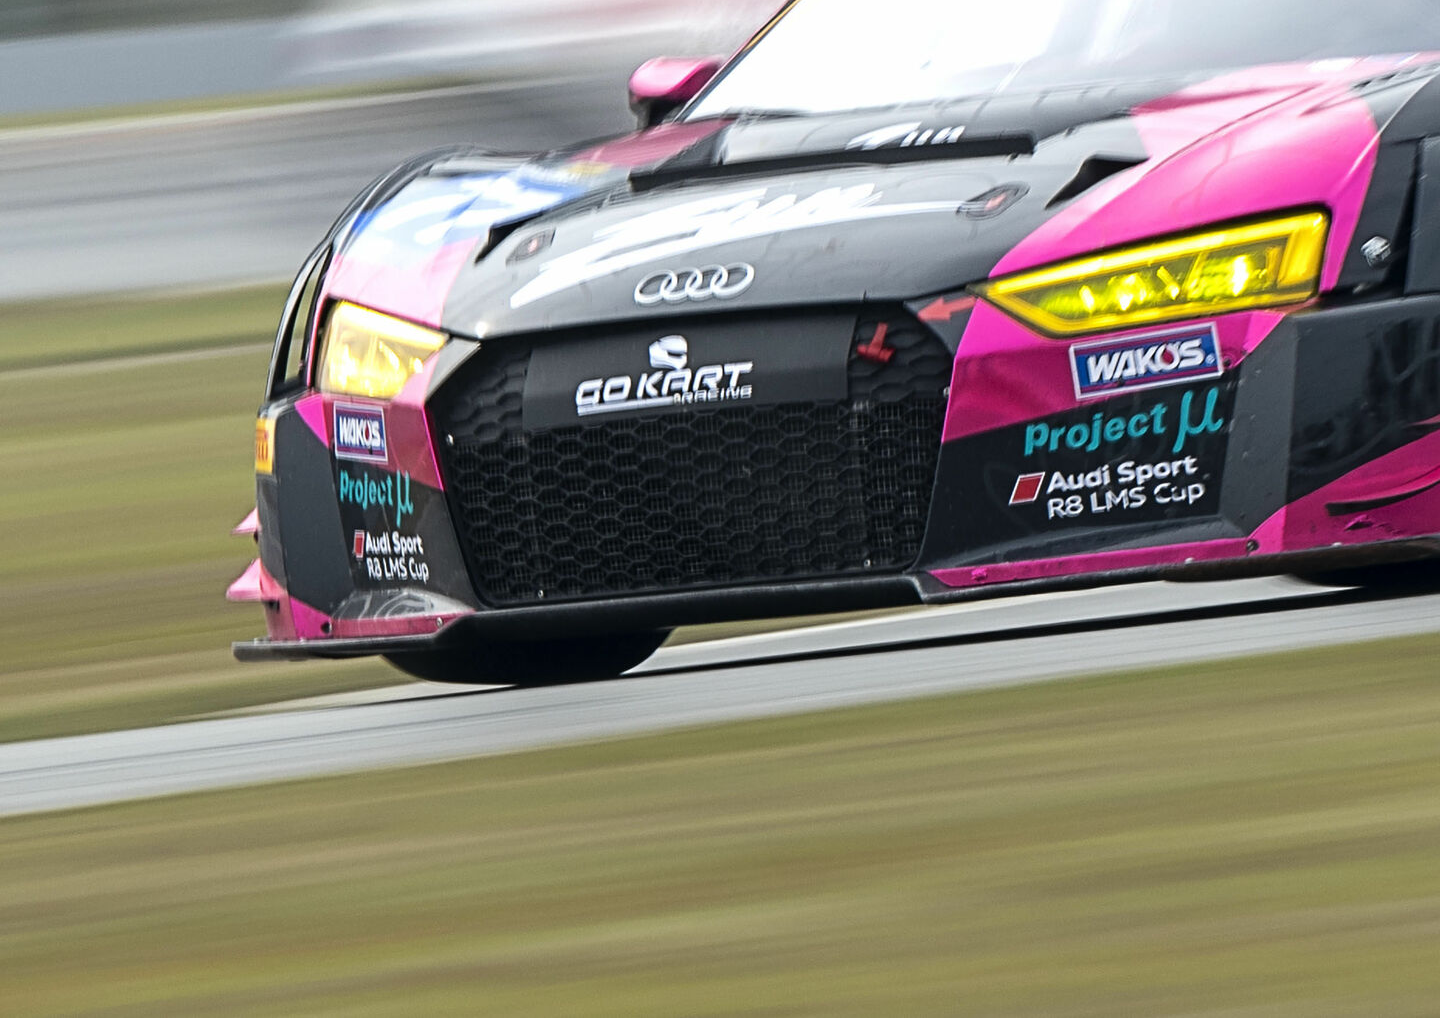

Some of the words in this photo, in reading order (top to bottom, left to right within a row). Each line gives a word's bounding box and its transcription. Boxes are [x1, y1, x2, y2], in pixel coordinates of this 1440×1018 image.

[636, 361, 753, 400] KART
[1024, 403, 1167, 457] Project
[340, 470, 393, 510] Project
[1046, 464, 1111, 494] Audi
[1116, 455, 1198, 485] Sport
[1047, 494, 1084, 520] R8
[1090, 486, 1147, 514] LMS
[1153, 483, 1206, 505] Cup
[365, 531, 390, 555] Audi
[392, 531, 425, 558] Sport
[366, 557, 382, 578] R8
[383, 558, 408, 581] LMS
[408, 558, 430, 583] Cup
